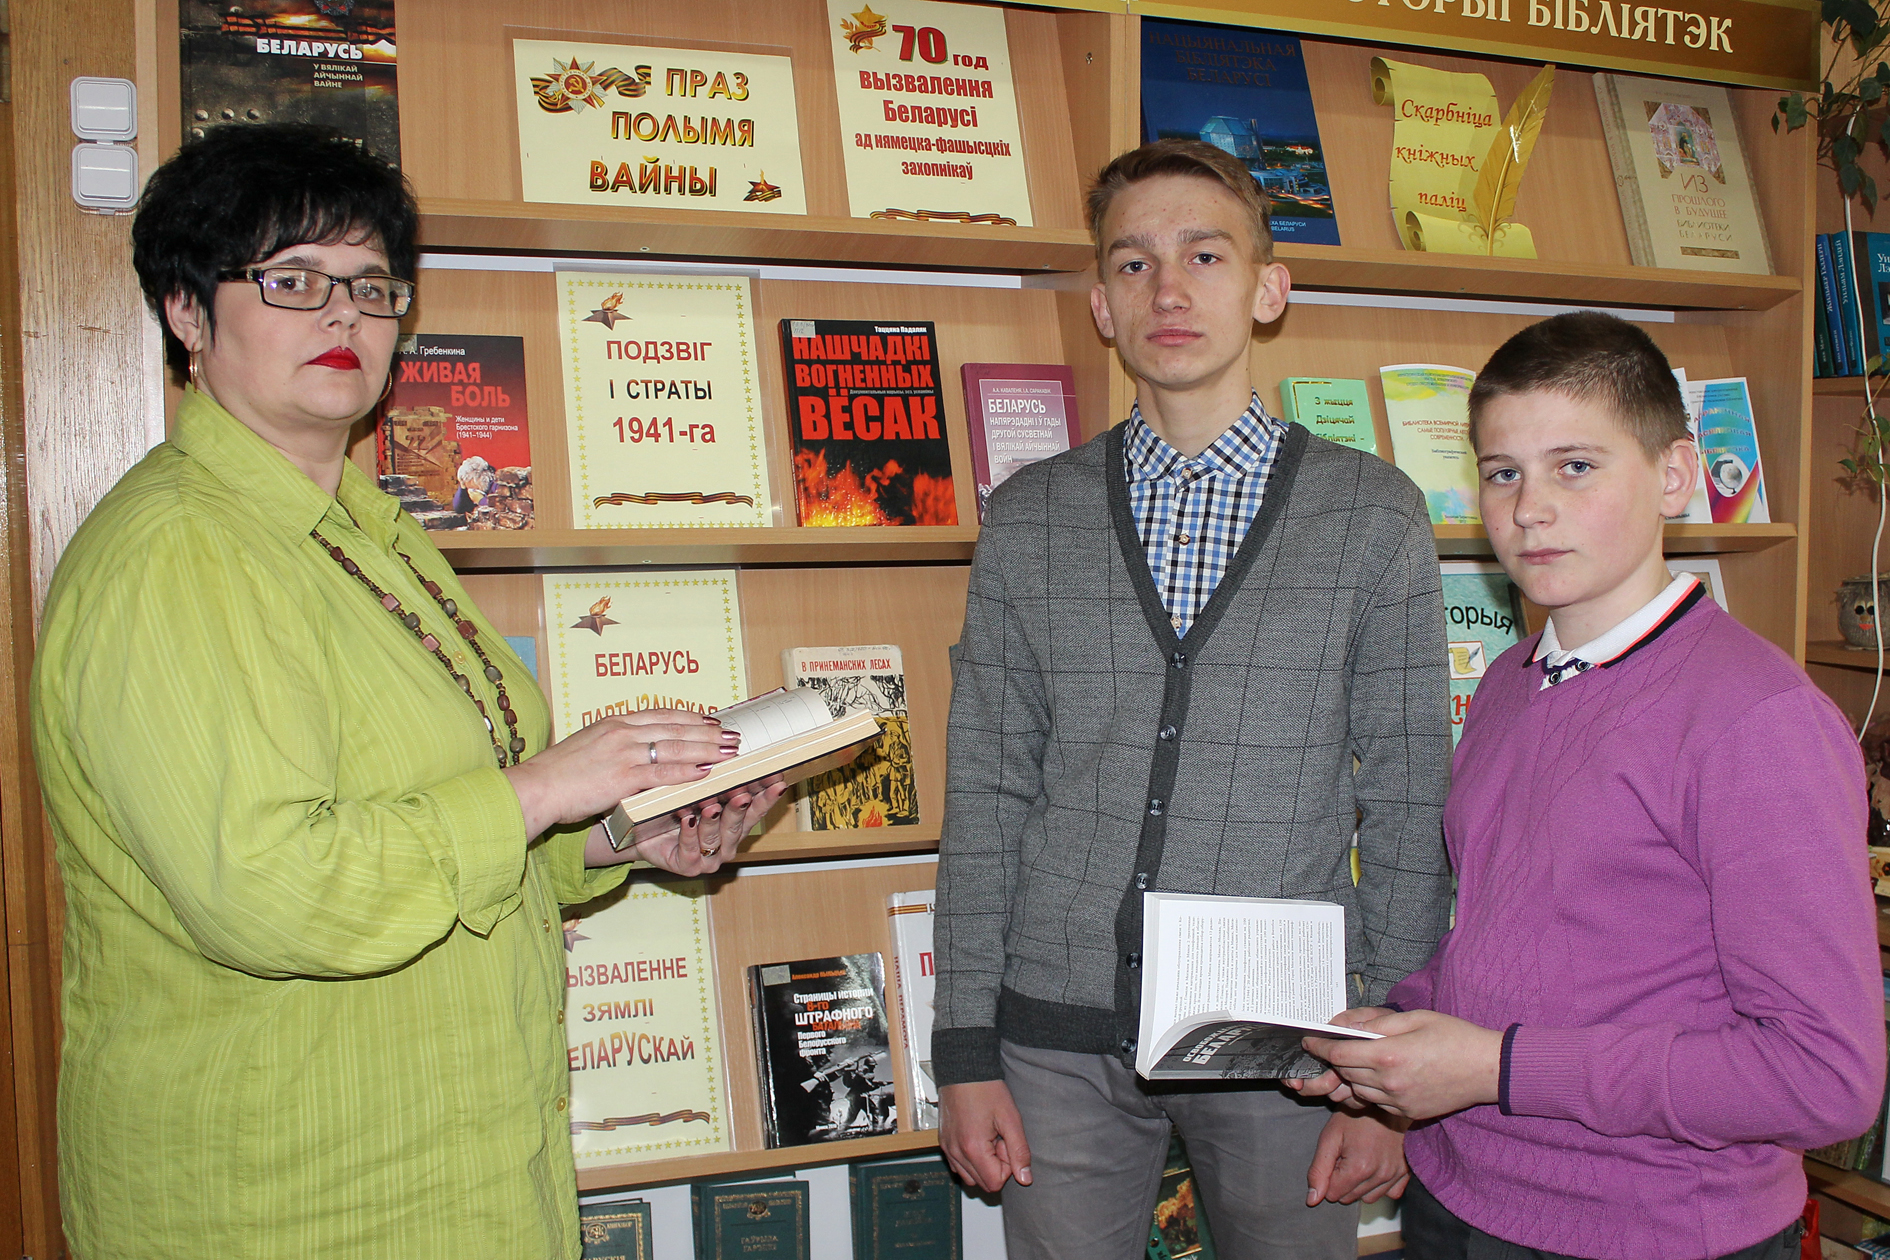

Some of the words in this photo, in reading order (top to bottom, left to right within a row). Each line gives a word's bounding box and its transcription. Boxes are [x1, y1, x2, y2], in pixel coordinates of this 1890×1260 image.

[1527, 0, 1733, 53] БІБЛІЯТЭК
[257, 38, 363, 59] БЕЛАРУСЬ
[892, 24, 949, 64] 70
[953, 54, 989, 71] год
[1148, 31, 1297, 57] НАЦЫЯНАЛЬНАЯ
[321, 64, 358, 73] ВЯЛІКАЙ
[1175, 50, 1277, 72] БІБЛІЯТЭКА
[314, 71, 364, 81] АЙЧЫННАЙ
[314, 80, 342, 88] ВАЙНЕ
[665, 67, 750, 101] ПРАЗ
[859, 70, 994, 99] вызвалення
[1187, 67, 1272, 87] БЕЛАРУСІ
[883, 99, 979, 128] Беларусі
[1401, 99, 1493, 128] Скарбніца
[610, 110, 755, 147] ПОЛЫМЯ
[855, 133, 872, 149] ад
[874, 134, 1012, 158] нямецка-фашысцкіх
[1395, 144, 1479, 172] кніжных
[589, 155, 717, 197] ВАЙНЫ
[901, 160, 974, 181] захопнікаў
[1680, 173, 1709, 193] ИЗ
[1417, 191, 1467, 212] паліц
[1671, 193, 1726, 208] ПРОШЛОГО
[1674, 206, 1680, 215] В
[1686, 206, 1728, 219] БУДУЩЕЕ
[420, 345, 466, 357] Гребенкина
[606, 340, 712, 364] ПОДЗВІГ
[792, 335, 931, 365] НАШЧАДКІ
[400, 361, 481, 383] ЖИВАЯ
[794, 364, 935, 388] ВОГНЕННЫХ
[451, 386, 511, 407] БОЛЬ
[609, 379, 615, 400] І
[626, 379, 713, 400] СТРАТЫ
[798, 388, 941, 441] ВЁСАК
[988, 399, 1047, 413] БЕЛАРУСЬ
[455, 415, 485, 423] Женщины
[455, 423, 488, 431] Брестского
[990, 417, 1034, 427] НАПЯРЭДАДНІ
[1044, 417, 1061, 428] ГАДЫ
[1316, 414, 1355, 425] Дзіцячай
[612, 416, 716, 444] 1941-га
[991, 428, 1016, 439] ДРУГОЙ
[1016, 428, 1053, 439] СУСВЕТНАЙ
[996, 440, 1025, 451] ВЯЛІКАЙ
[1025, 440, 1060, 451] АЙЧЫННАЙ
[994, 453, 1013, 464] ВОЙН
[594, 650, 700, 678] БЕЛАРУСЬ
[801, 662, 807, 672] В
[869, 659, 892, 670] ЛЕСАХ
[566, 957, 688, 988] ЫЗВАЛЕННЕ
[793, 991, 837, 1004] Страницы
[838, 988, 874, 1000] истории
[806, 1001, 830, 1011] 8-го
[582, 998, 654, 1022] ЗЯМЛІ
[794, 1006, 874, 1026] ШТРАФНОГО
[797, 1030, 826, 1040] Первого
[812, 1020, 862, 1031] БАТАЛЬОНА
[567, 1030, 695, 1072] ЕЛАРУСКАЙ
[798, 1037, 847, 1049] Белорусского
